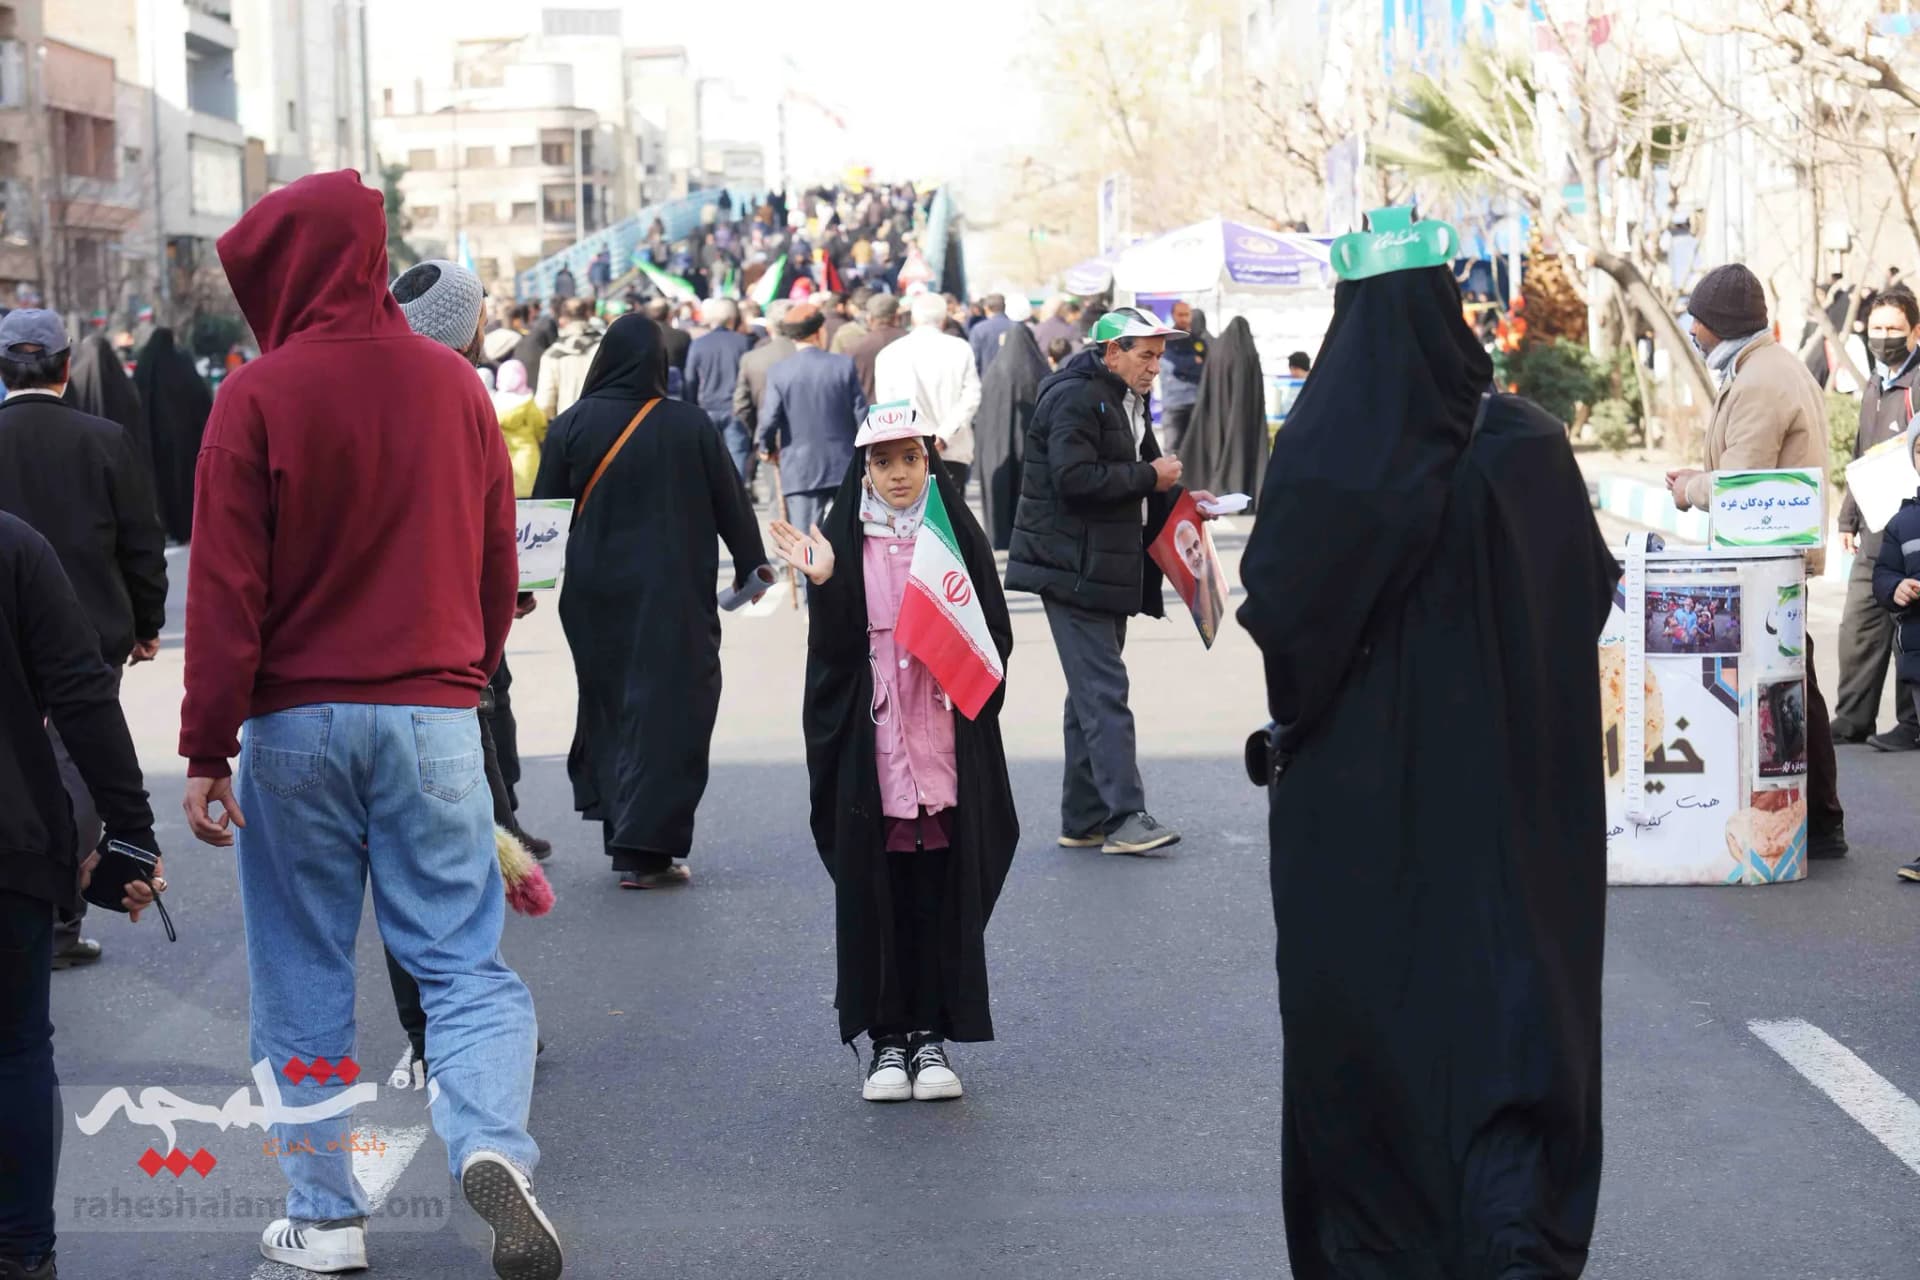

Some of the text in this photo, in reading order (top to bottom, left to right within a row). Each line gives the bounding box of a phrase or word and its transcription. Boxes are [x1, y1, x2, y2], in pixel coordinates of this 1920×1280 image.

[1721, 496, 1811, 511] کمک به کودکان غزه
[1676, 795, 1720, 808] همت
